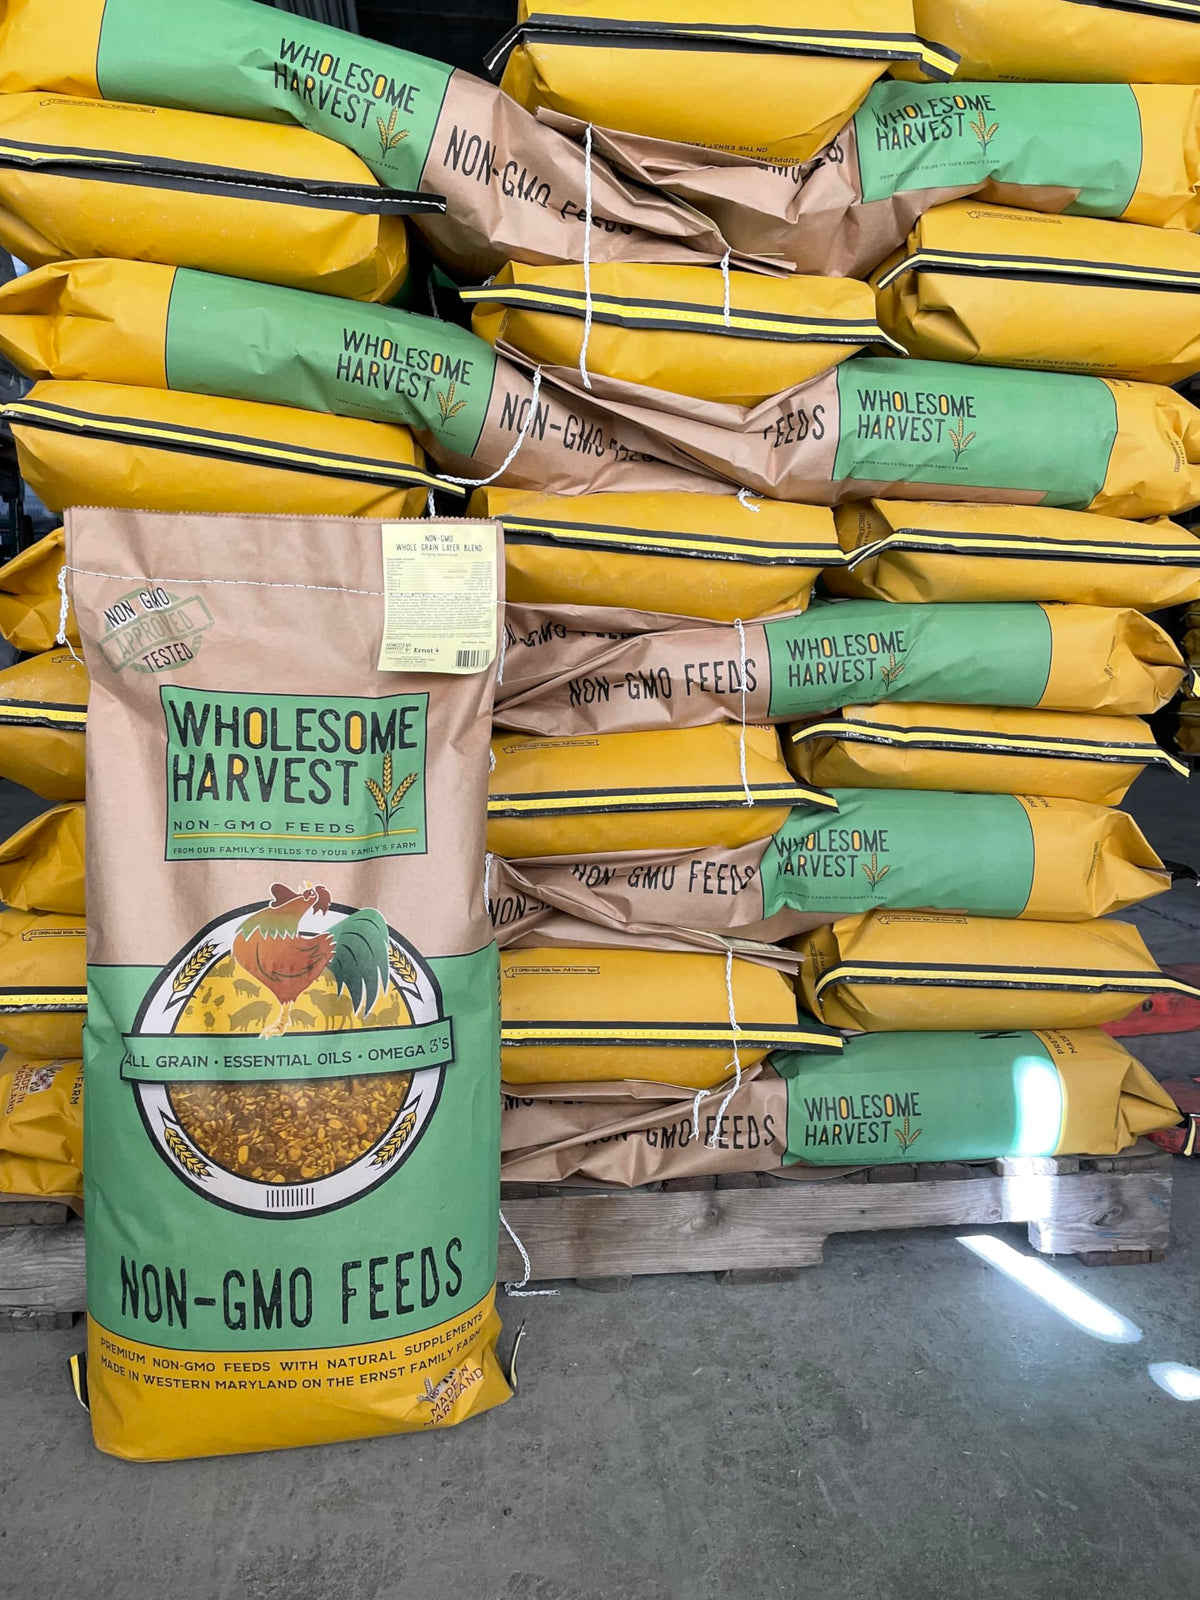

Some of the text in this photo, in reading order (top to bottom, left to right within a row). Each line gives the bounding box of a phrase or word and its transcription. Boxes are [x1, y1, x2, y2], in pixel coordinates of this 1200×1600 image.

[280, 38, 420, 114] WHOLESOME
[274, 62, 376, 129] HARVEST
[872, 94, 996, 129] WHOLESOME
[876, 113, 965, 151] HARVEST
[443, 125, 552, 208] NON-GMO
[343, 328, 474, 386] WHOLESOME
[336, 353, 435, 402] HARVEST
[857, 389, 977, 418] WHOLESOME
[500, 392, 606, 457] NON-GMO
[857, 414, 946, 443] HARVEST
[395, 543, 417, 551] WHOLE
[463, 544, 483, 552] BLEND
[425, 534, 454, 542] NON-GMO
[104, 587, 170, 628] NON GMO
[115, 609, 194, 659] APPROVED
[786, 630, 908, 661] WHOLESOME
[142, 642, 194, 673] TESTED
[788, 657, 877, 687] HARVEST
[568, 658, 757, 707] NON-GMO FEEDS
[168, 700, 419, 755] WHOLESOME
[173, 753, 359, 806] HARVEST
[173, 820, 355, 834] NON-GMO FEEDS
[771, 829, 890, 858] WHOLESOME
[197, 846, 215, 854] OUR
[220, 846, 265, 854] FAMILY'S
[268, 847, 302, 855] FIELDS
[351, 843, 388, 856] FAMILY'S
[390, 842, 416, 850] FARM
[124, 1037, 450, 1068] ALL GRAIN ESSENTIAL OILS OMEGA 3'S
[70, 1076, 84, 1105] FARM
[804, 1092, 922, 1122] WHOLESOME
[704, 1114, 776, 1149] FEEDS
[805, 1121, 891, 1146] HARVEST
[120, 1237, 463, 1331] NON-GMO FEEDS
[100, 1311, 483, 1373] PREMIUM NON-GMO FEEDS WITH NATURAL SUPPLEMENTS
[100, 1328, 481, 1390] MADE IN WESTERN MARYLAND ON THE ERNST FAMILY FARM
[430, 1364, 469, 1416] MADE IN
